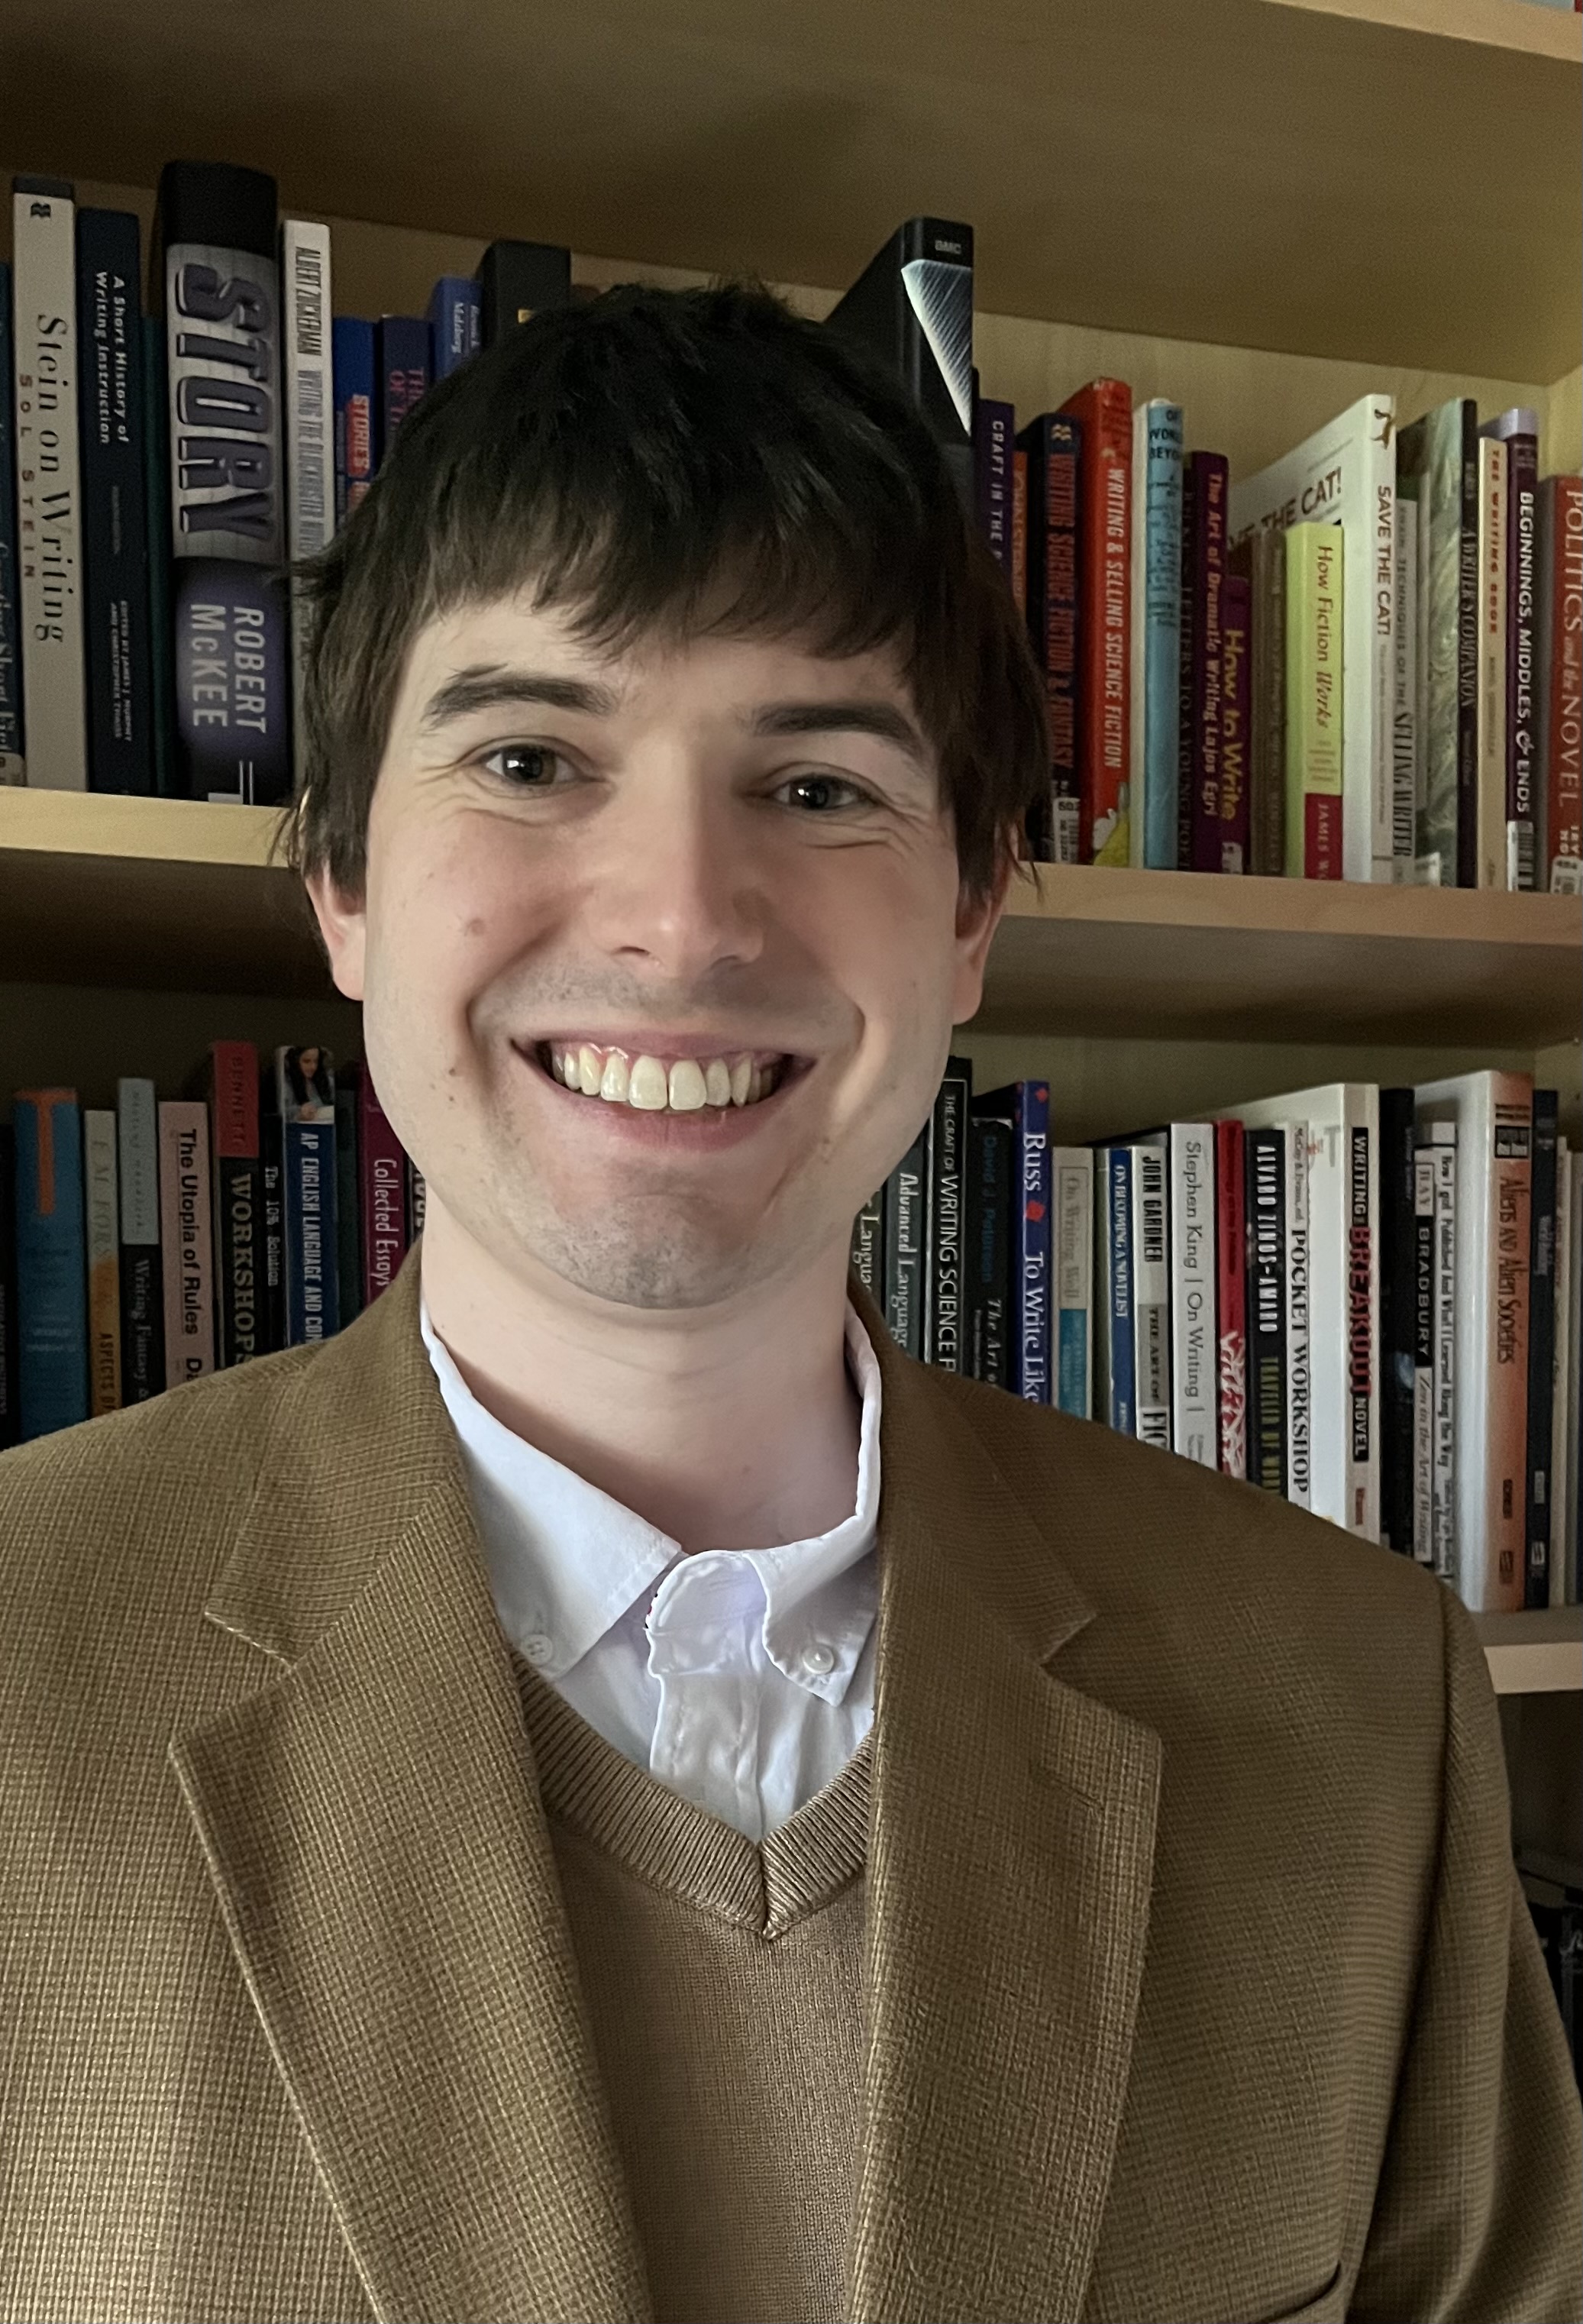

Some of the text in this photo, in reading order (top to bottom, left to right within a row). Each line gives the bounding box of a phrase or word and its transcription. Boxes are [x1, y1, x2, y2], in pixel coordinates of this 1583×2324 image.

[94, 272, 111, 444] Writing Instruction
[114, 276, 129, 442] A Short History of
[176, 263, 273, 538] STORY
[351, 394, 370, 469] STORIES
[19, 374, 35, 577] SOL STEIN
[35, 315, 73, 643] Stein on Writing
[992, 421, 1004, 474] CRAFT
[991, 511, 1003, 541] THE
[992, 483, 1003, 500] IN
[1048, 454, 1075, 527] WRITING
[1261, 466, 1342, 531] THE CAT!
[1378, 485, 1391, 541] SAVE
[1048, 533, 1074, 600] SCIENCE
[1378, 545, 1391, 582] THE
[1491, 492, 1500, 573] WRITING
[1048, 608, 1074, 671] FICTION
[1104, 469, 1126, 768] WRITING & SELLING SCIENCE FICTION
[1203, 474, 1222, 816] The Art of Dramatic Writing Lajos Egri
[1316, 545, 1334, 729] How Fiction Works
[1377, 590, 1391, 636] CAT!
[1515, 491, 1535, 813] BEGINNINGS, MIDDLES, & ENDS
[1559, 490, 1583, 807] POLITICS and the NOVEL
[190, 604, 228, 727] McKEE
[234, 606, 266, 733] ROBERT
[1459, 615, 1476, 706] COMPANION
[1222, 629, 1244, 821] How to Write
[1394, 558, 1413, 856] TECHNIQUES OF THE SELLING WRITER
[1317, 803, 1329, 852] JAMES
[944, 1119, 955, 1154] CRAFT
[945, 1095, 956, 1113] THE
[944, 1157, 955, 1172] OF
[1023, 1132, 1046, 1191] Russ
[1418, 1171, 1430, 1207] RAY
[1499, 1176, 1526, 1223] Aliens
[179, 1128, 202, 1335] The Utopia of Rules
[265, 1166, 280, 1287] The 10% Solution
[300, 1133, 322, 1312] AP ENGLISH LANGUAGE AND
[370, 1159, 399, 1287] Collected Essays
[899, 1172, 919, 1253] Advanced
[940, 1175, 959, 1261] WRITING
[1062, 1177, 1081, 1298] On Writing Well
[1115, 1164, 1128, 1317] ON BECOMING A NOVELIST
[1183, 1140, 1203, 1269] Stephen King
[131, 1259, 150, 1320] Writing
[938, 1269, 958, 1352] SCIENCE
[1142, 1156, 1164, 1400] JOHN GARDNER THE ART OF
[1291, 1229, 1307, 1333] POCKET
[1349, 1136, 1371, 1456] WRITING BREAKOUT NOVEL
[1417, 1227, 1430, 1356] BRADBURY
[1498, 1257, 1525, 1295] Alien
[99, 1333, 114, 1390] ASPECTS
[133, 1324, 151, 1382] Fantasy
[987, 1298, 1003, 1369] The Art
[1023, 1251, 1045, 1403] To Write Like
[1185, 1291, 1204, 1398] On Writing
[1497, 1299, 1522, 1365] Societies
[1292, 1343, 1309, 1493] WORKSHOP
[1420, 1375, 1432, 1405] Zen
[1418, 1456, 1430, 1479] Art
[1419, 1427, 1430, 1447] the
[1417, 1481, 1430, 1495] of
